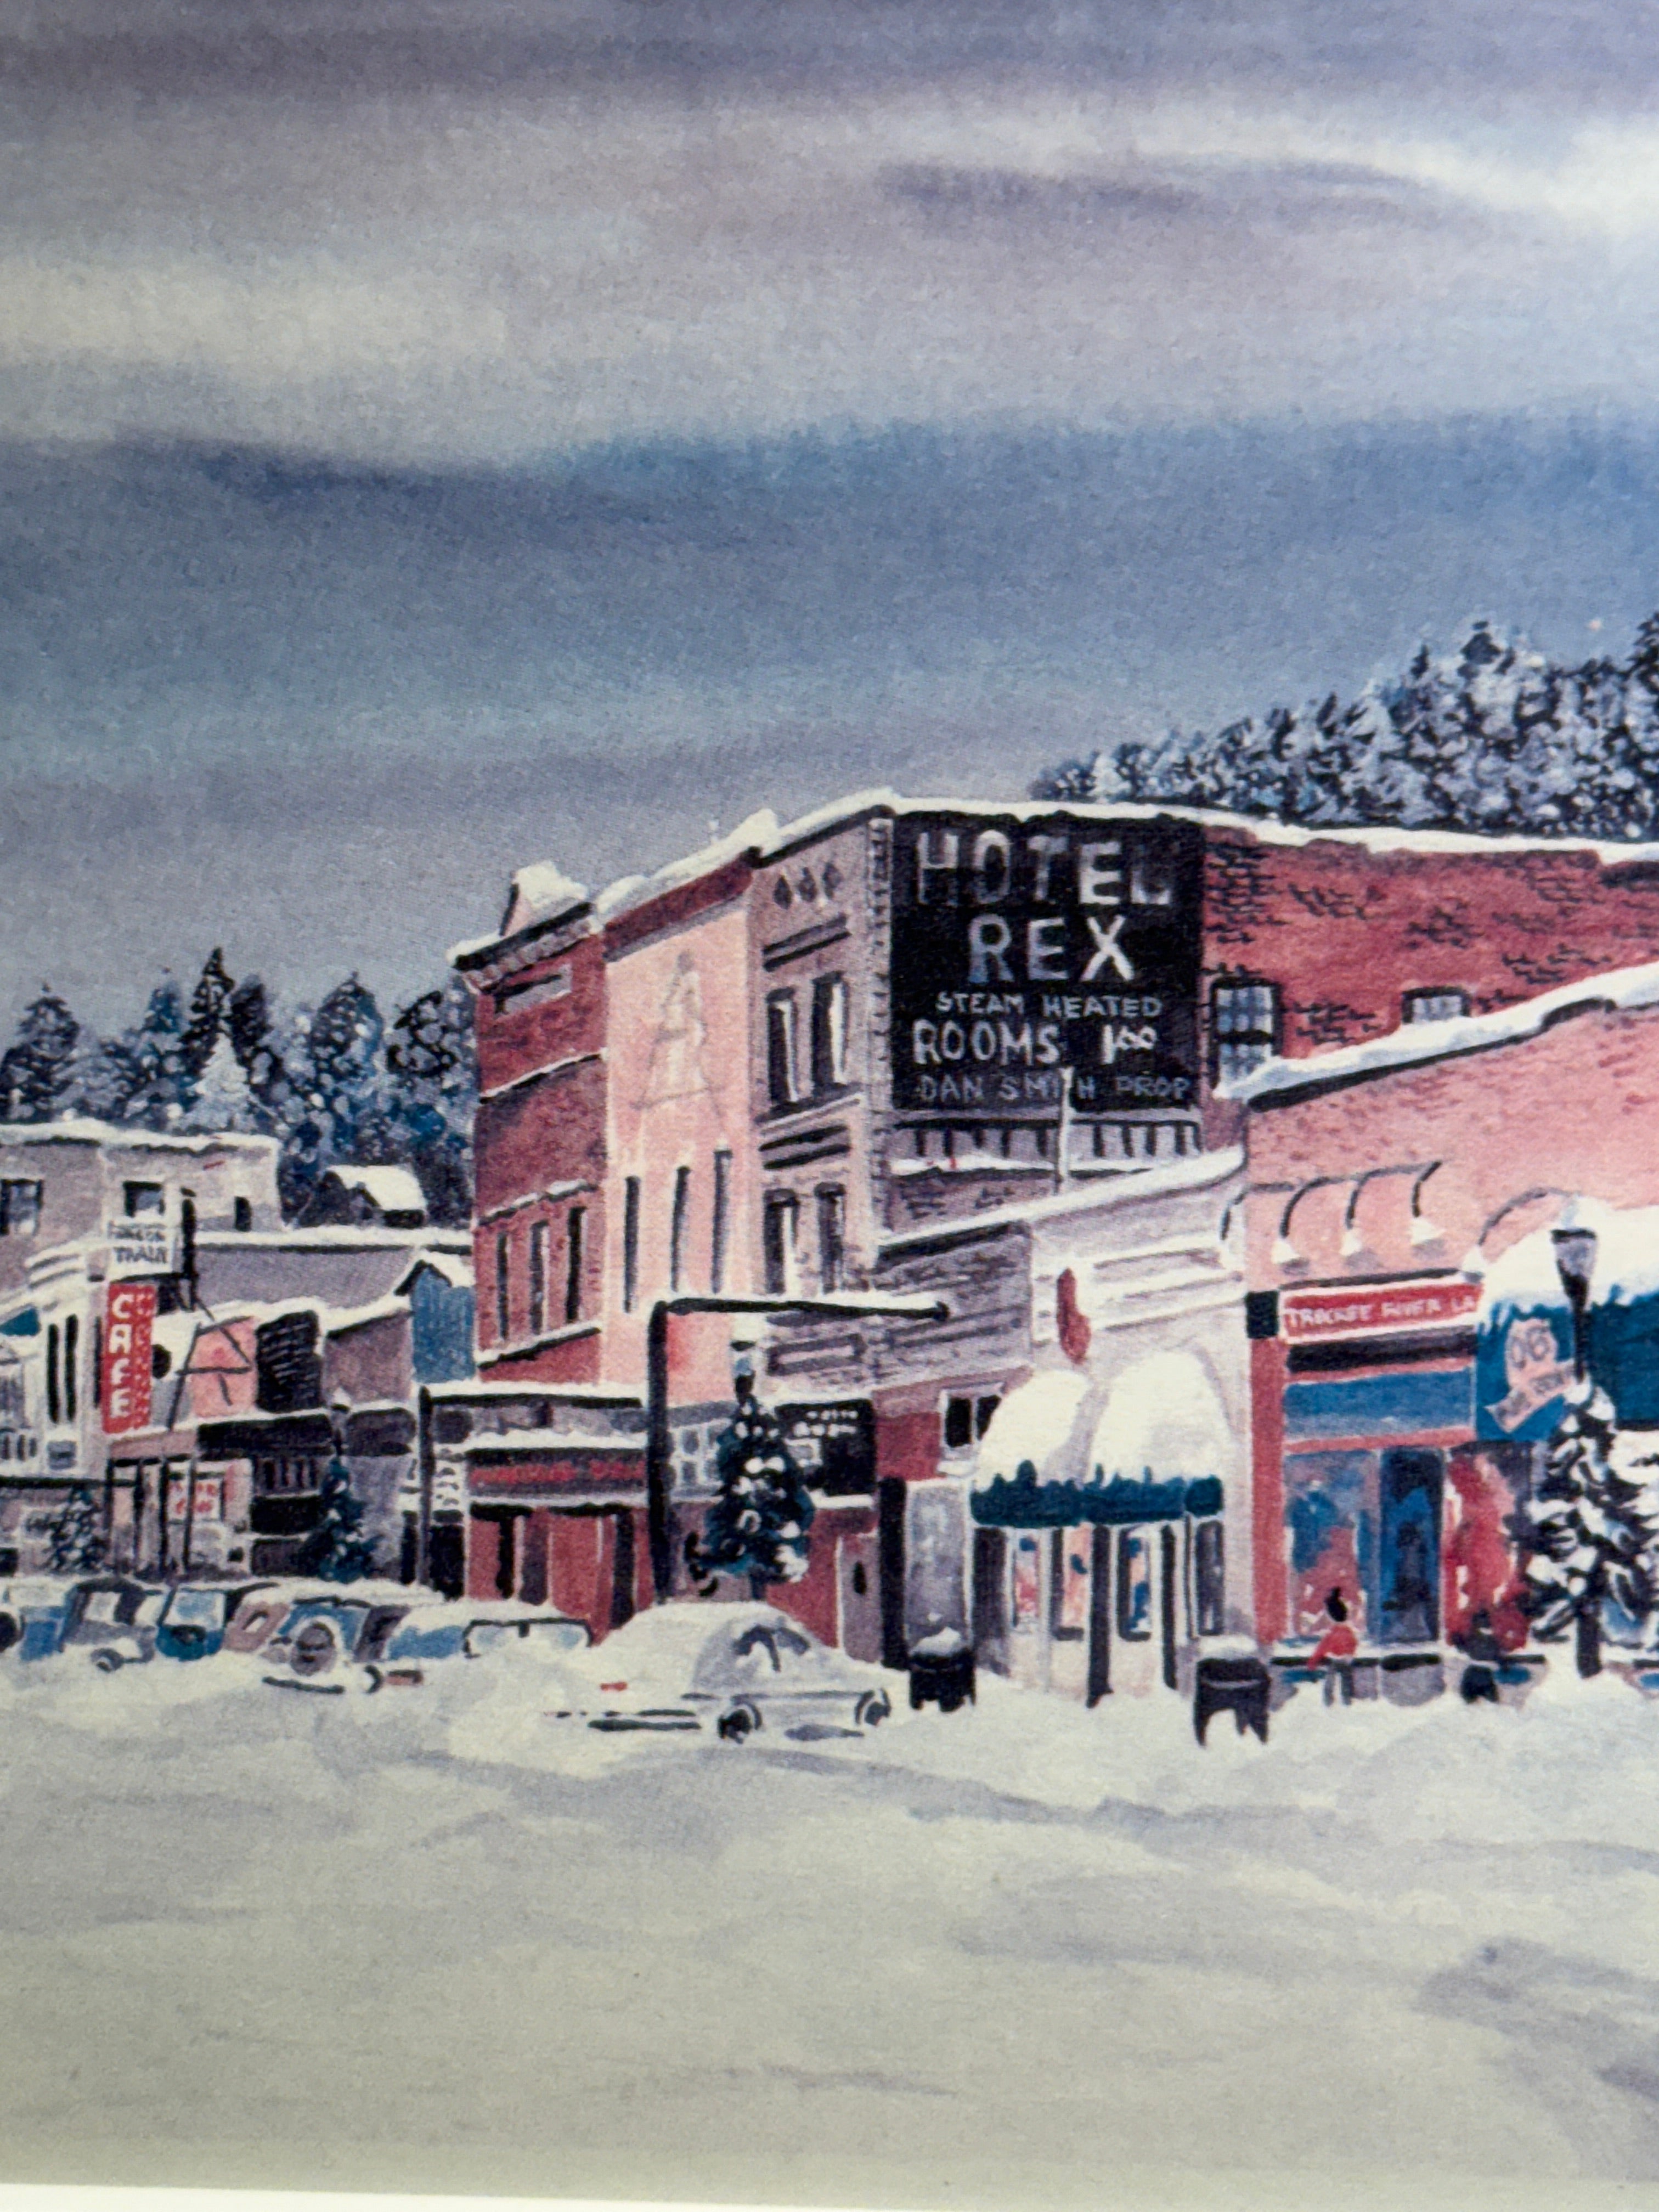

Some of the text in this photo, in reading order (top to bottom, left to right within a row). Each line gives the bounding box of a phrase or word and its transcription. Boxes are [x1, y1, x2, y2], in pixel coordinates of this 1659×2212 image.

[916, 830, 1171, 906] HOTEL
[969, 913, 1135, 984] REX
[935, 991, 1163, 1019] STEAM HEATED
[912, 1019, 1060, 1065] ROOMS
[919, 1071, 1191, 1102] DAN SMIH PROP
[109, 1293, 135, 1418] CAFE
